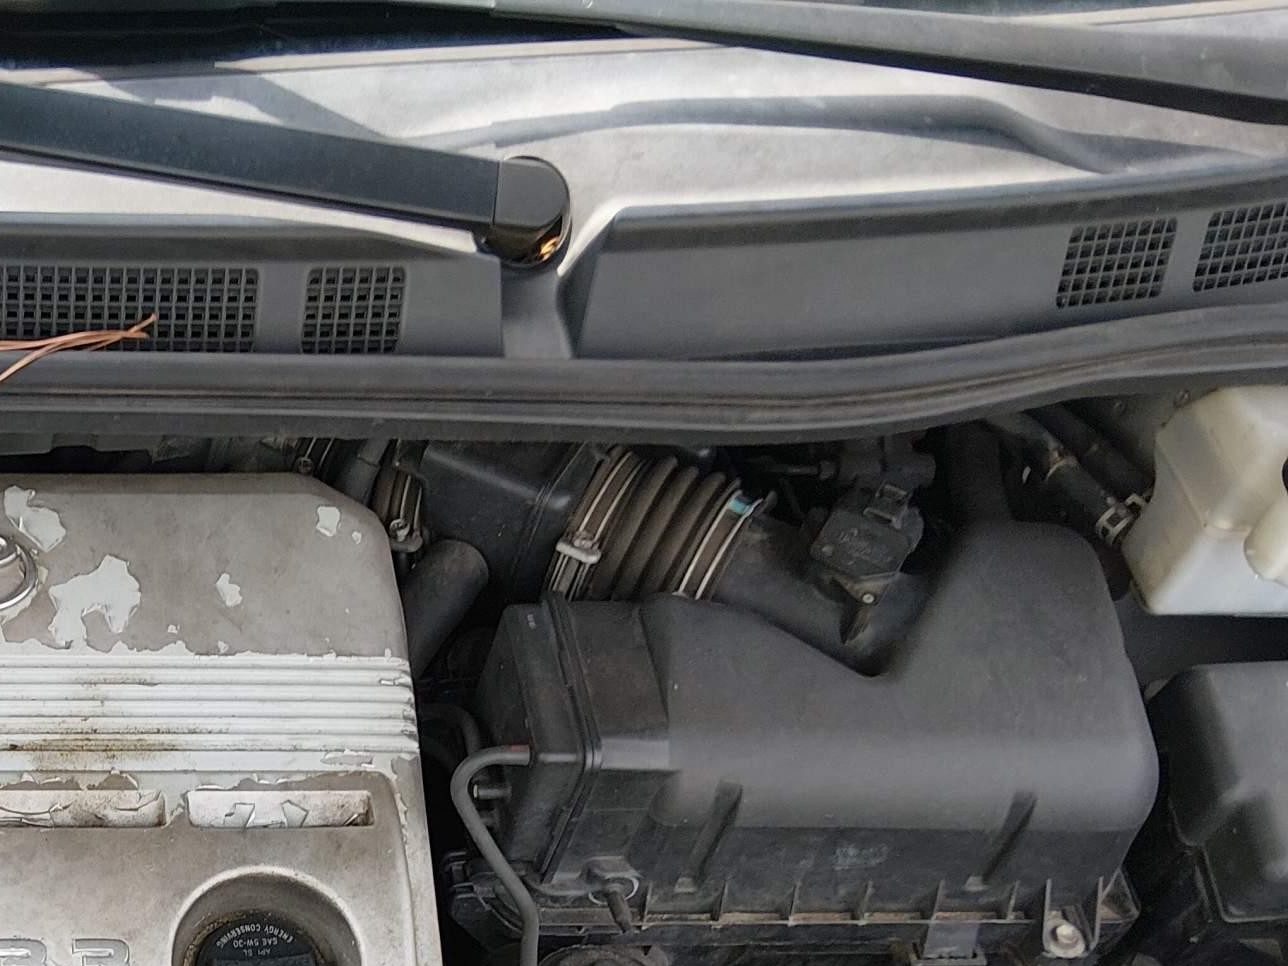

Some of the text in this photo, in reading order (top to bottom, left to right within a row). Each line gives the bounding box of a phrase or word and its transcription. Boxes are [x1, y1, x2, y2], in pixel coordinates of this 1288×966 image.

[216, 923, 294, 948] ENERGY CONSERVING
[233, 938, 259, 949] 5W-30
